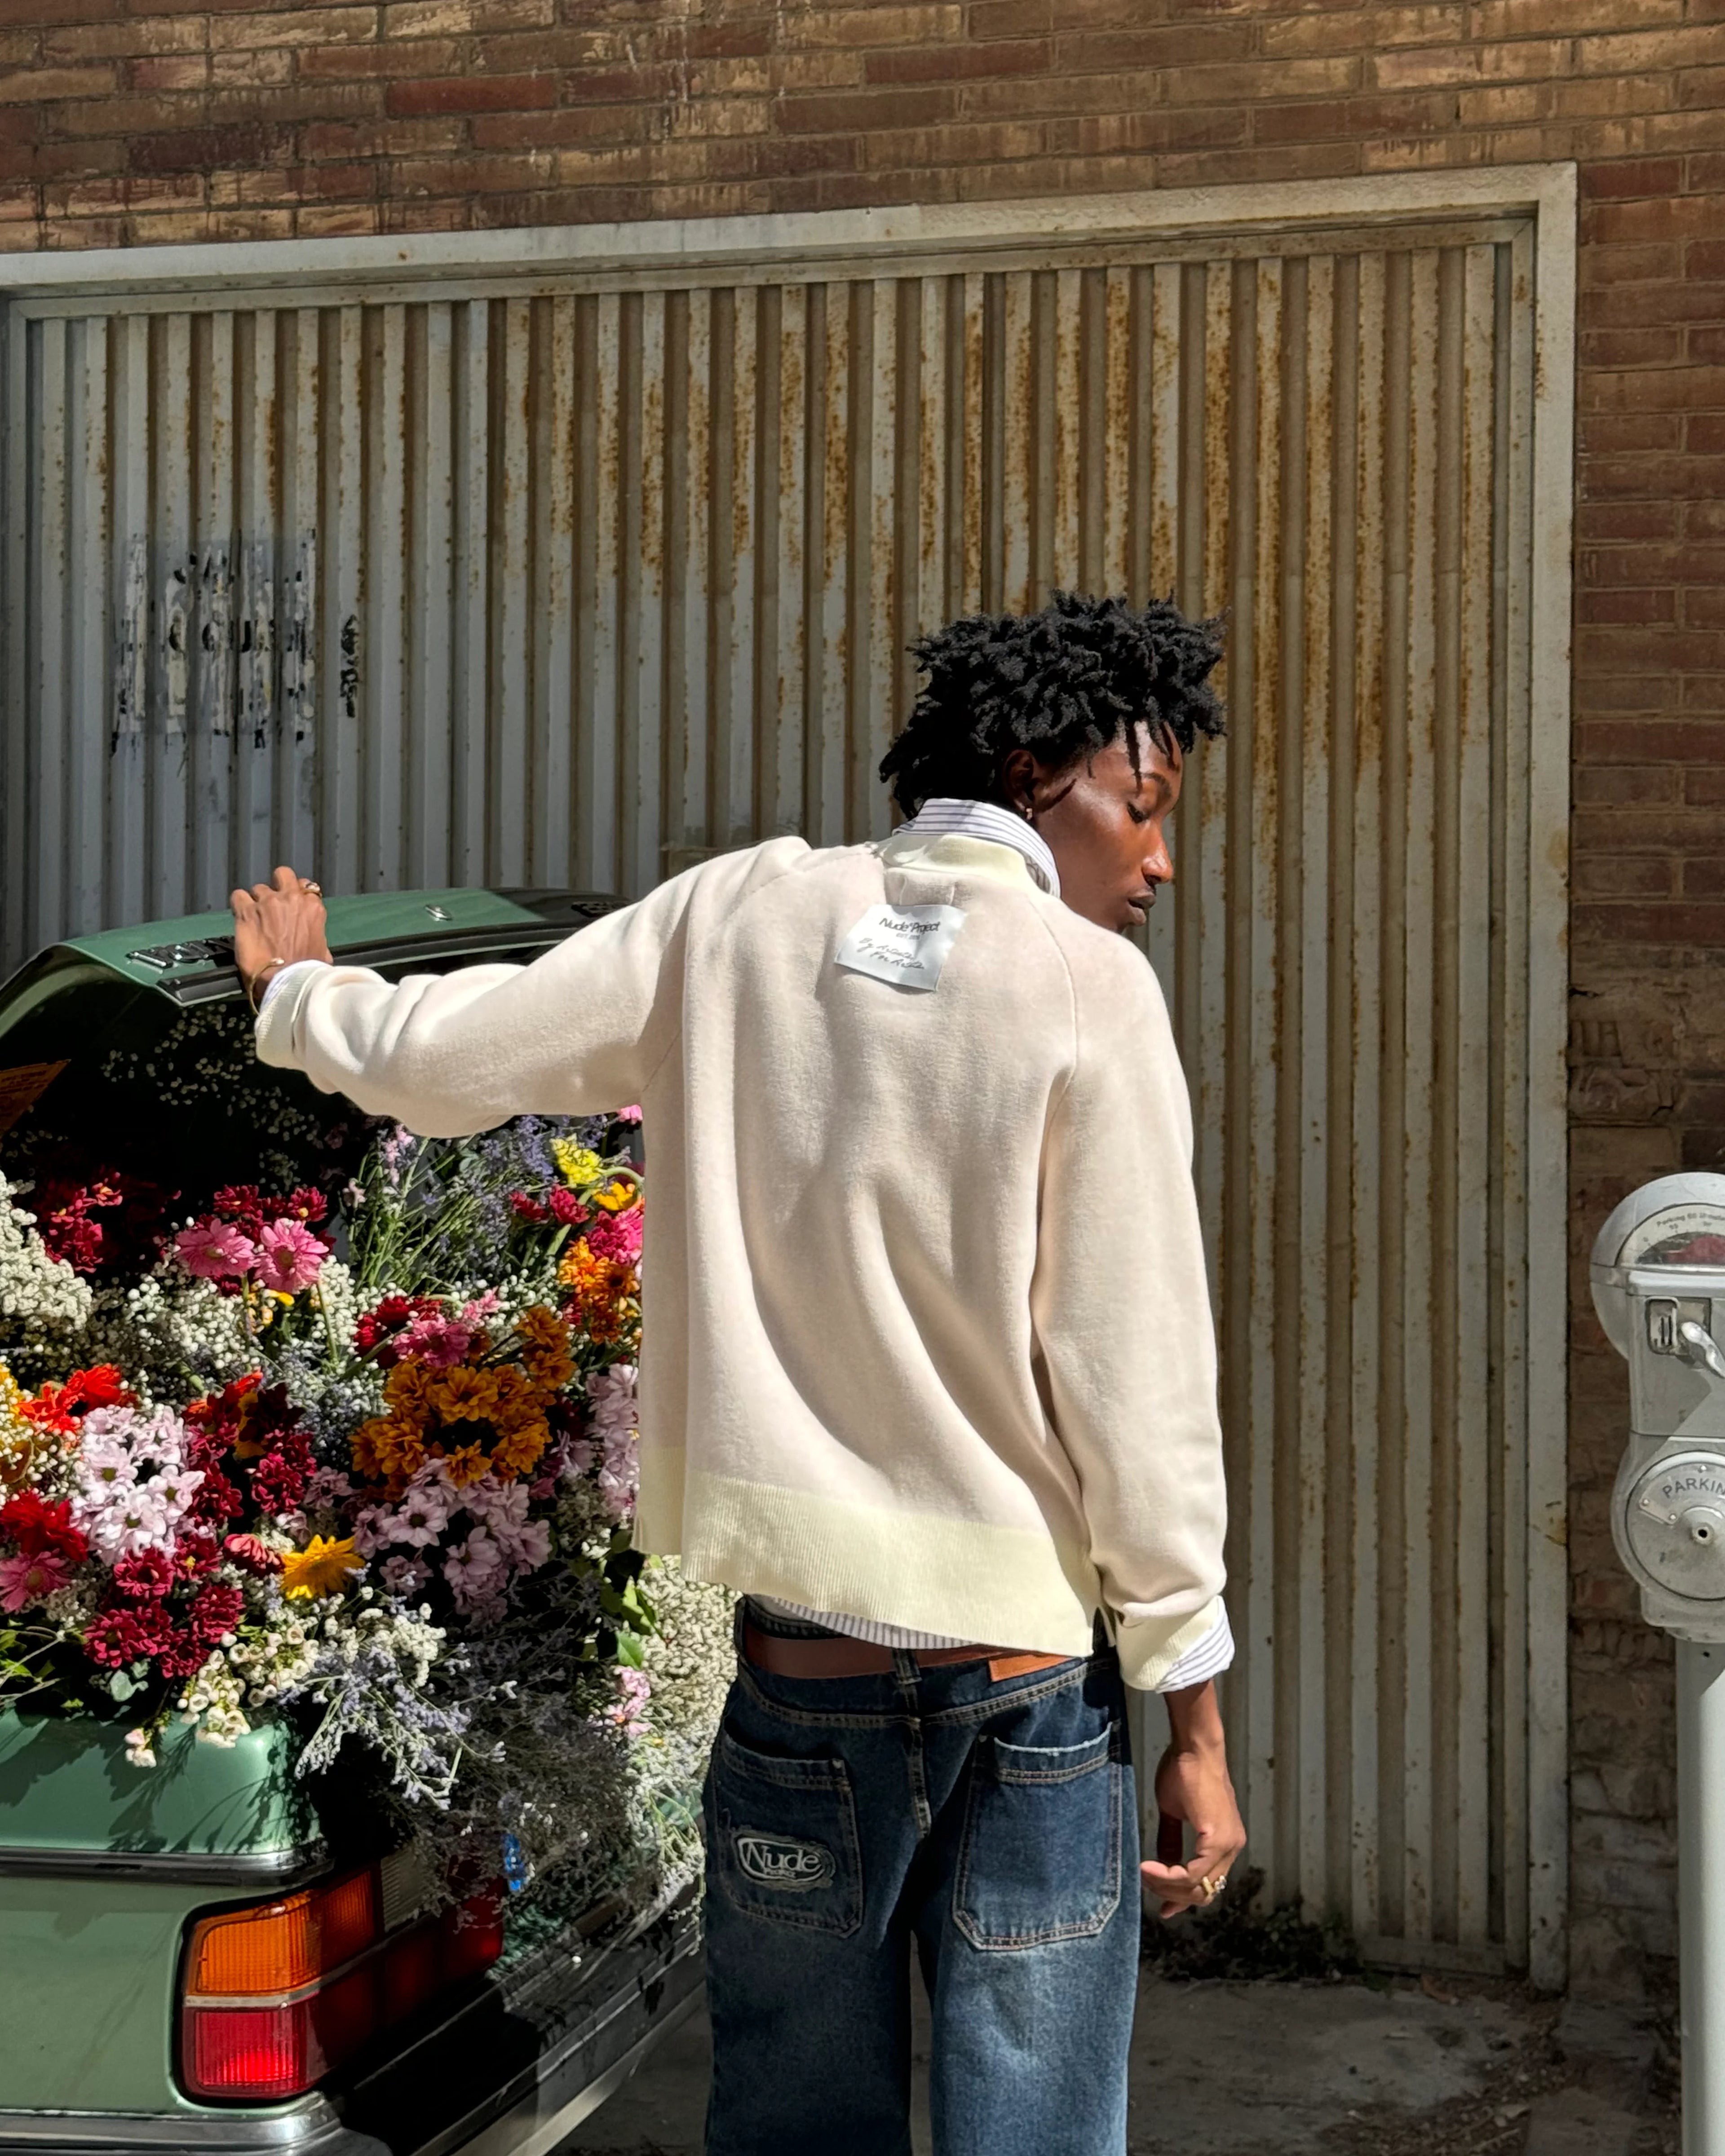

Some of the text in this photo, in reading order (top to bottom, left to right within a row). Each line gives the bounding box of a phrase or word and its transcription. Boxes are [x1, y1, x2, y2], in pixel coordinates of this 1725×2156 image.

[125, 935, 234, 968] VOLV
[1662, 1478, 1725, 1498] PARKIN
[746, 1842, 822, 1873] Nude
